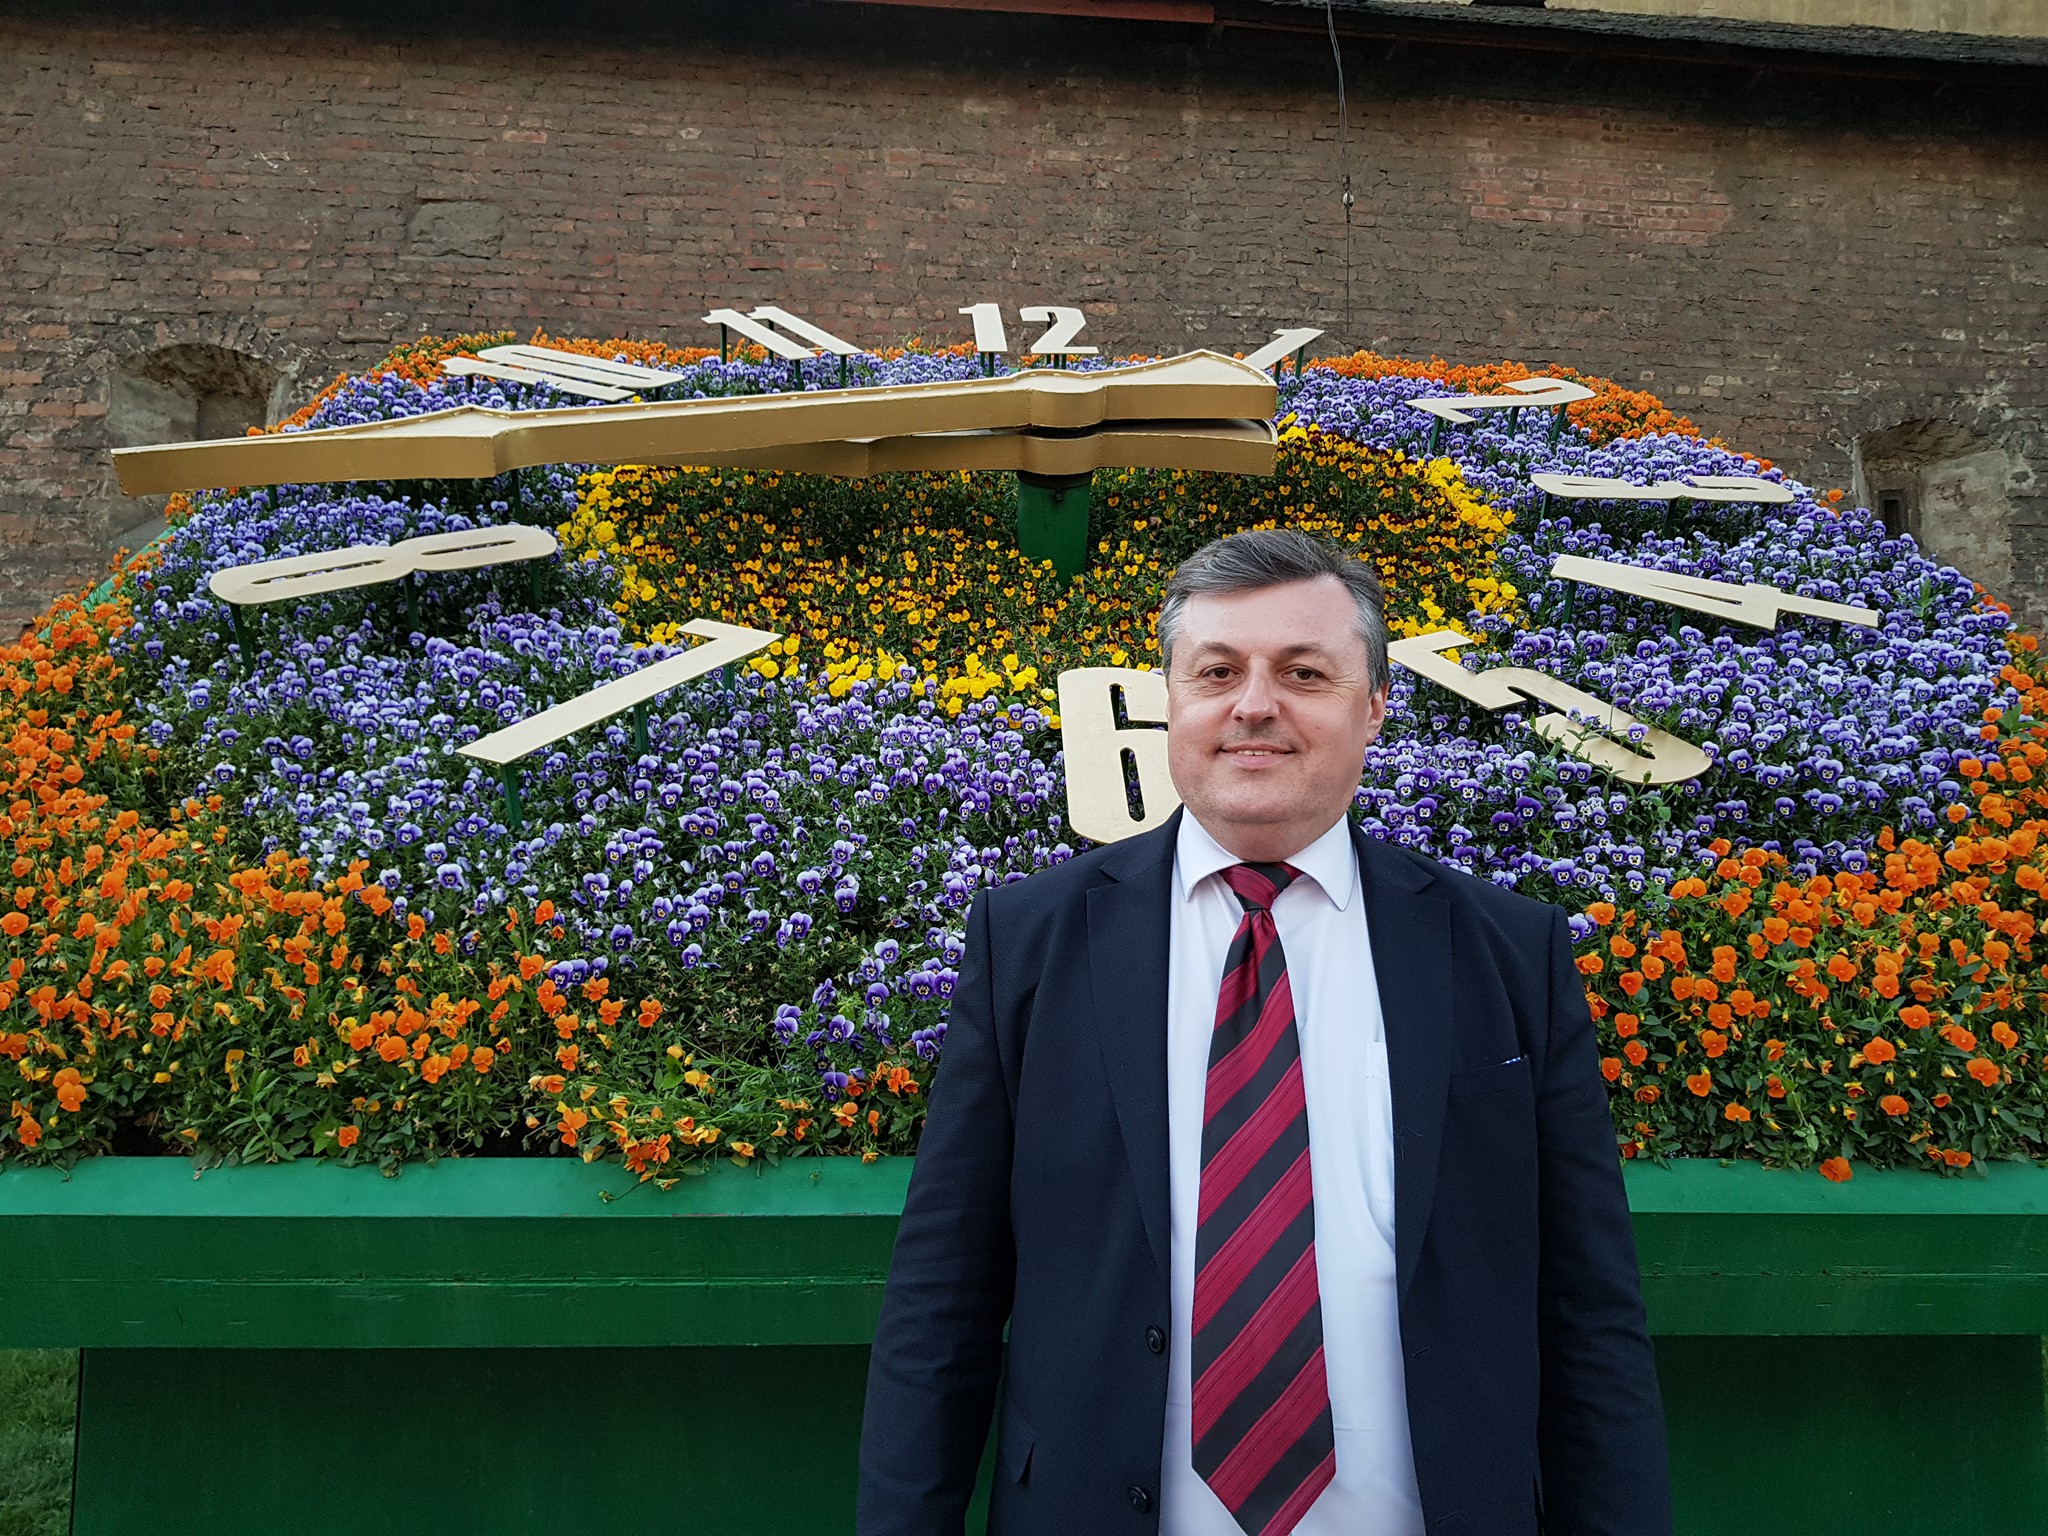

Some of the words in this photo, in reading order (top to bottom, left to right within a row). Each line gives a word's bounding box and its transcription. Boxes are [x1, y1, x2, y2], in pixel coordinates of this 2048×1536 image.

[701, 306, 864, 361] 11
[958, 303, 1100, 354] 12
[1243, 327, 1326, 371] 1
[439, 344, 687, 402] 10
[1405, 377, 1597, 424] 2
[1530, 473, 1795, 503] 3
[209, 525, 557, 605] 8
[1550, 554, 1879, 631] 4
[455, 617, 783, 765] 7
[1387, 630, 1713, 785] 5
[1057, 667, 1183, 844] 6
